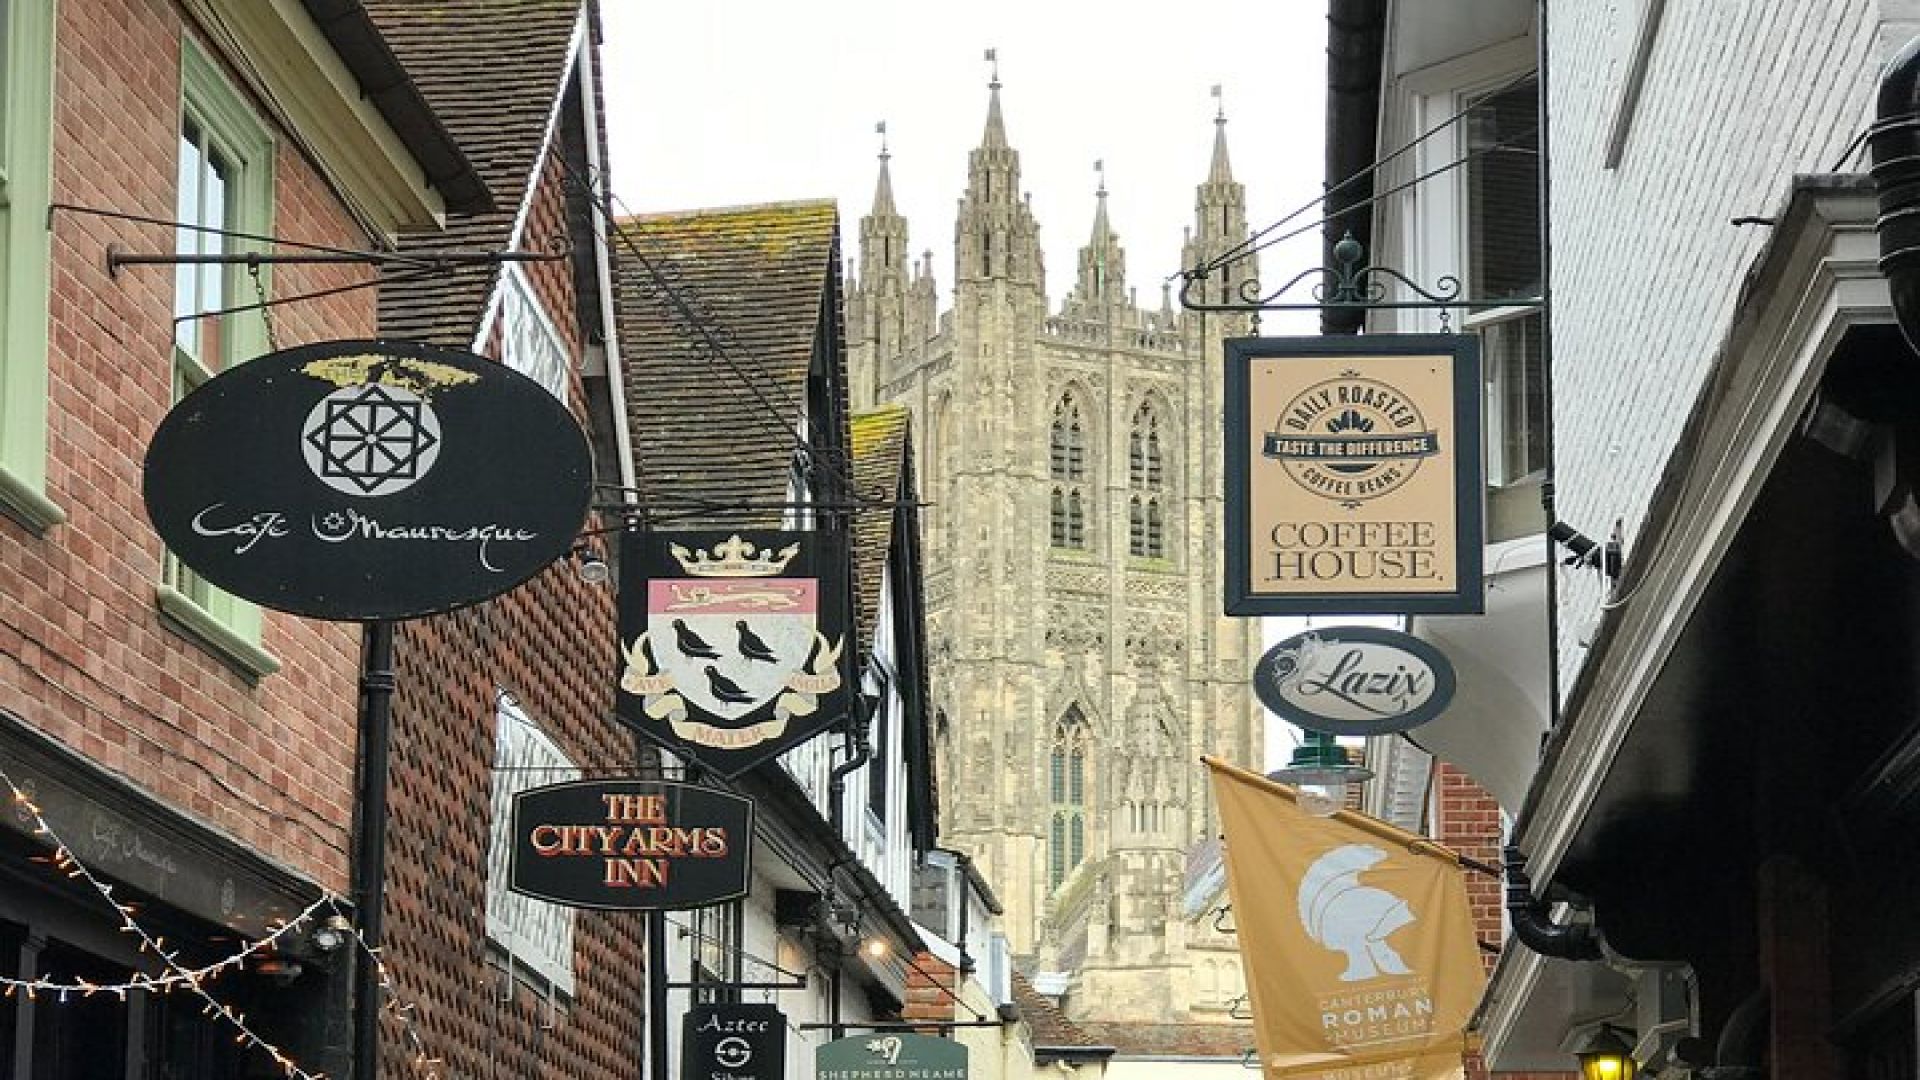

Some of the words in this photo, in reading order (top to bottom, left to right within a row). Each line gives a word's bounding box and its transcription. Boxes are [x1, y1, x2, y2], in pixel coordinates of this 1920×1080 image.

[1285, 388, 1332, 430] DAILY
[1337, 386, 1417, 429] ROASTED
[1275, 439, 1316, 455] TASTE
[1319, 441, 1345, 455] THE
[1347, 438, 1429, 456] DIFFERENCE
[1302, 467, 1352, 495] COFFEE
[1357, 467, 1401, 494] BEANS
[311, 508, 540, 572] Mauresque
[1271, 521, 1436, 548] COFFEE
[1297, 649, 1428, 716] Lazix
[602, 793, 668, 824] THE
[530, 825, 623, 857] CITY
[623, 826, 729, 857] ARMS
[604, 857, 672, 888] INN
[696, 1013, 769, 1032] Aztec
[1322, 998, 1433, 1029] ROMAN
[911, 1069, 965, 1079] NEAME
